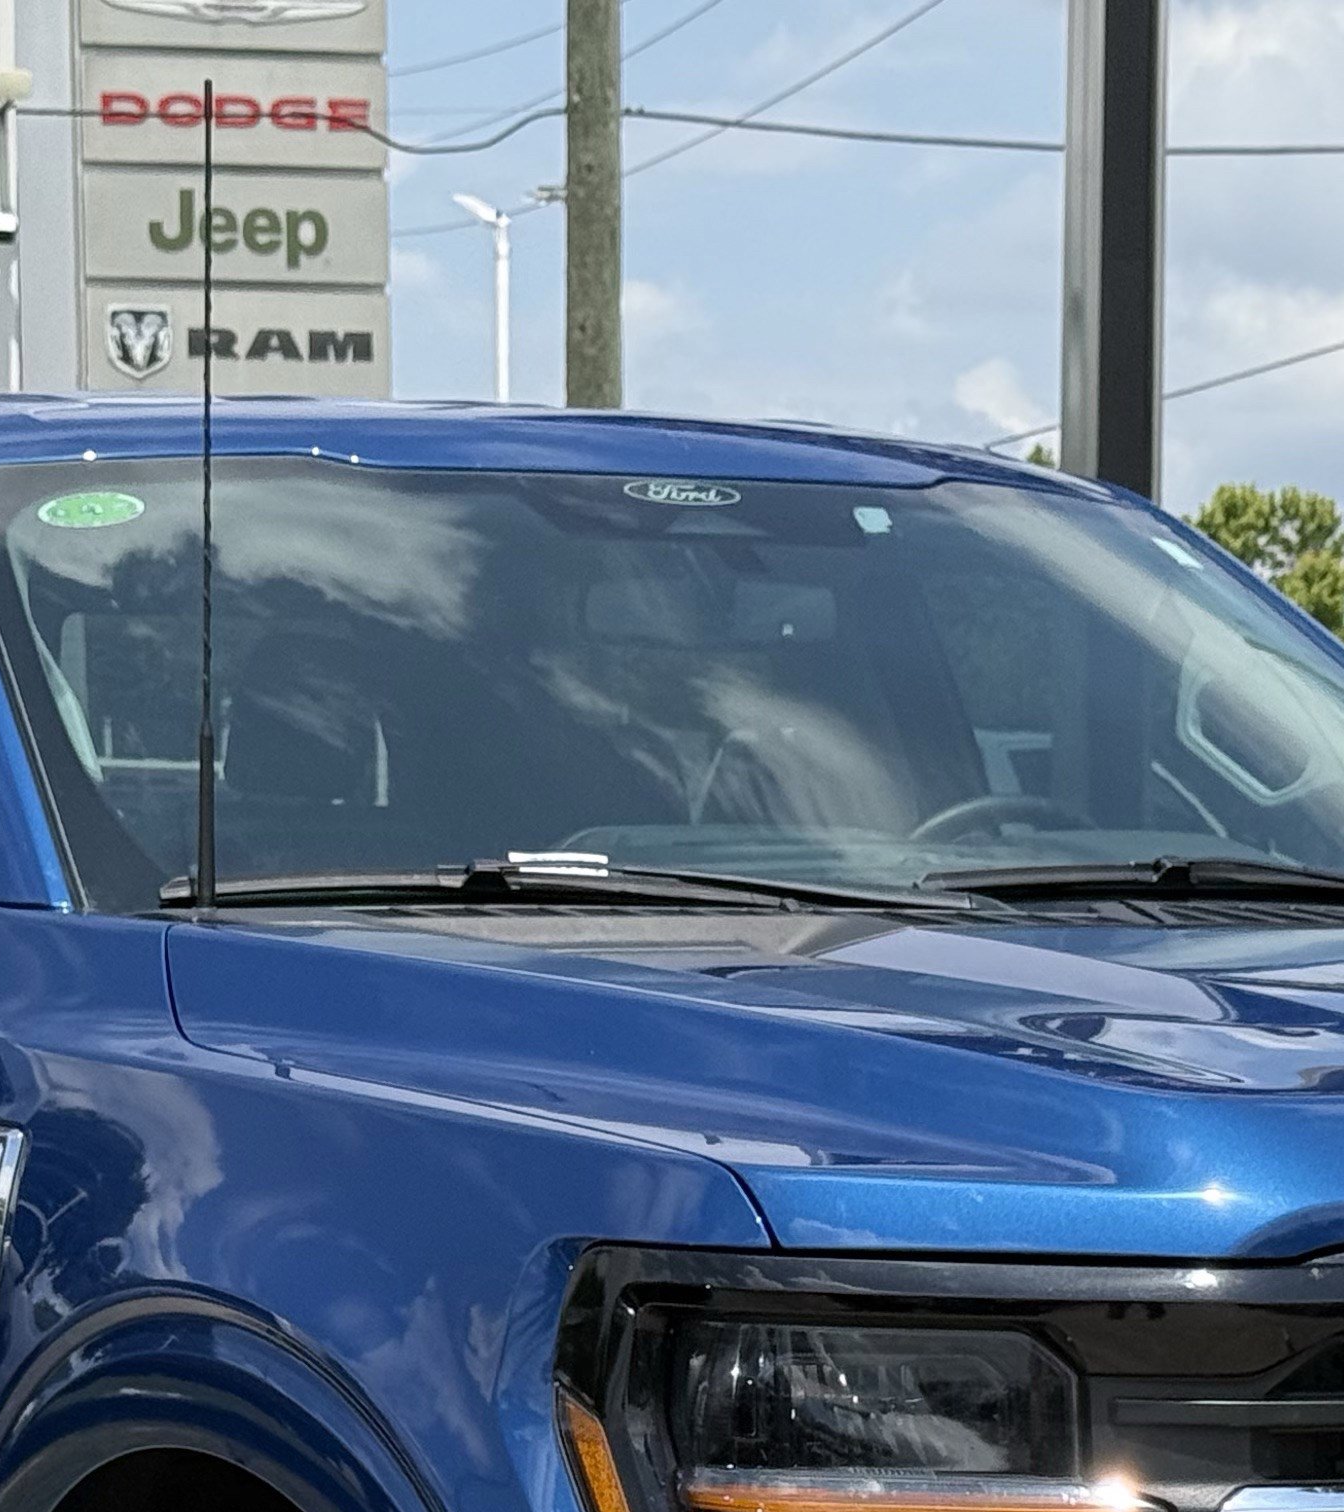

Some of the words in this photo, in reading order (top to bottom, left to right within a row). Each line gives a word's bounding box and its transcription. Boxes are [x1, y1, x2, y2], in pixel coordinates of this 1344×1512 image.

[100, 92, 370, 132] DODGE
[148, 188, 329, 270] Jeep
[187, 327, 374, 362] RAM
[647, 481, 722, 502] Ford
